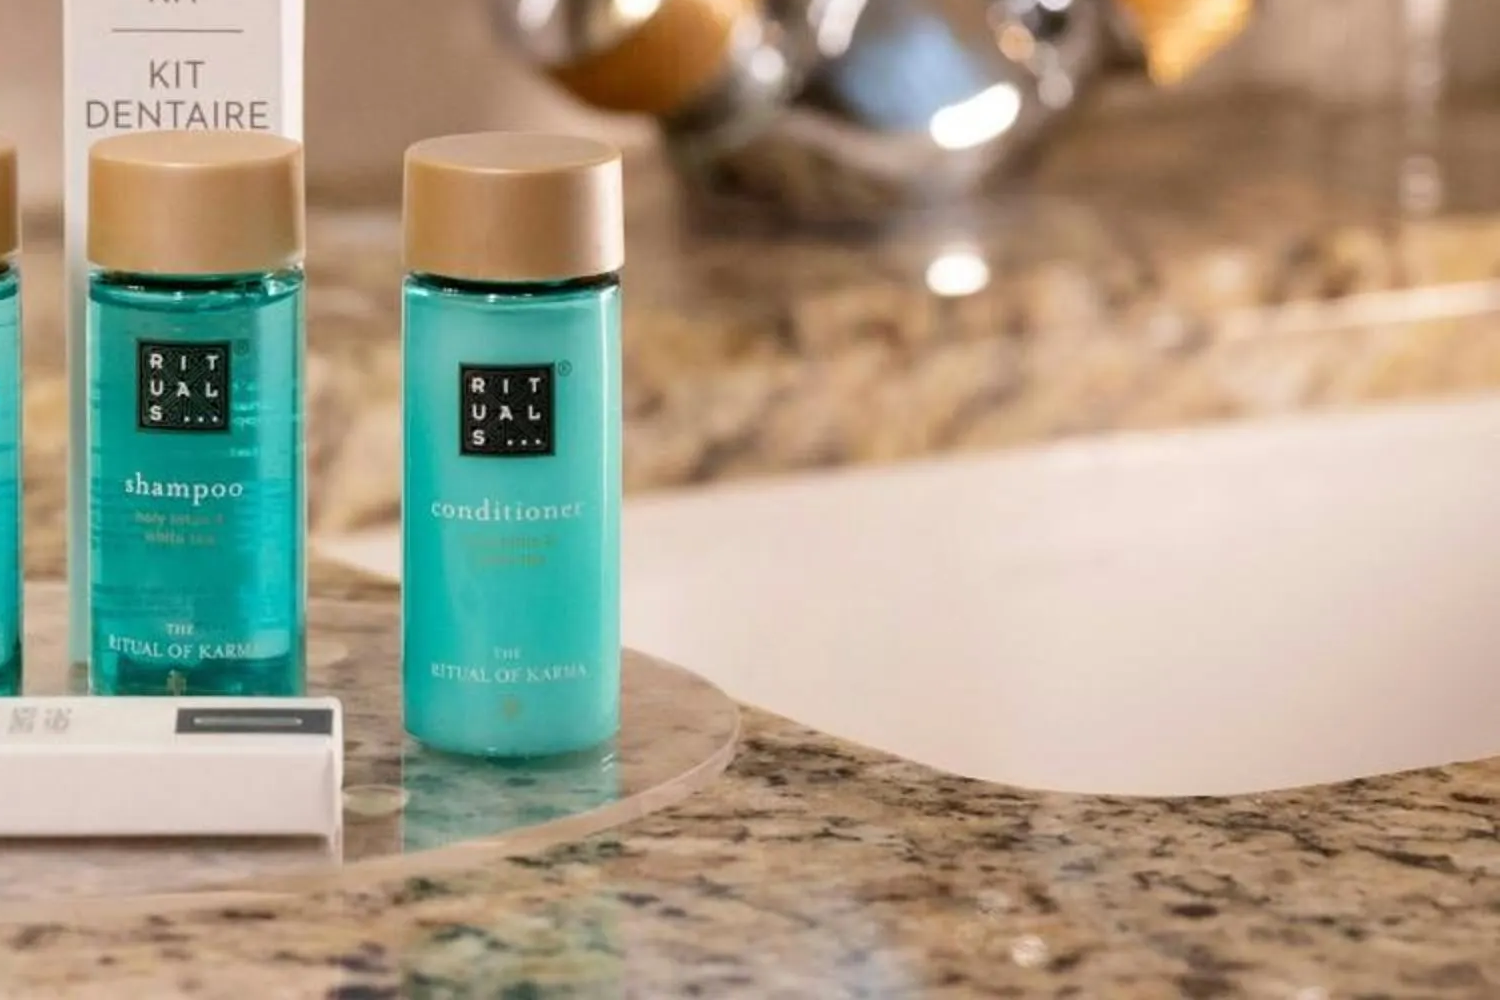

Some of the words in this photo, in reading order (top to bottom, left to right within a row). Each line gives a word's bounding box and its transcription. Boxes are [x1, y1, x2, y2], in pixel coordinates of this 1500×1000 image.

[148, 60, 206, 90] KIT
[86, 100, 270, 131] DENTAIRE
[125, 471, 244, 507] shampoo
[430, 498, 585, 522] conditioner
[108, 634, 164, 658] RITUAL
[167, 643, 194, 659] OF
[431, 663, 492, 683] RITUAL
[495, 667, 521, 684] OF
